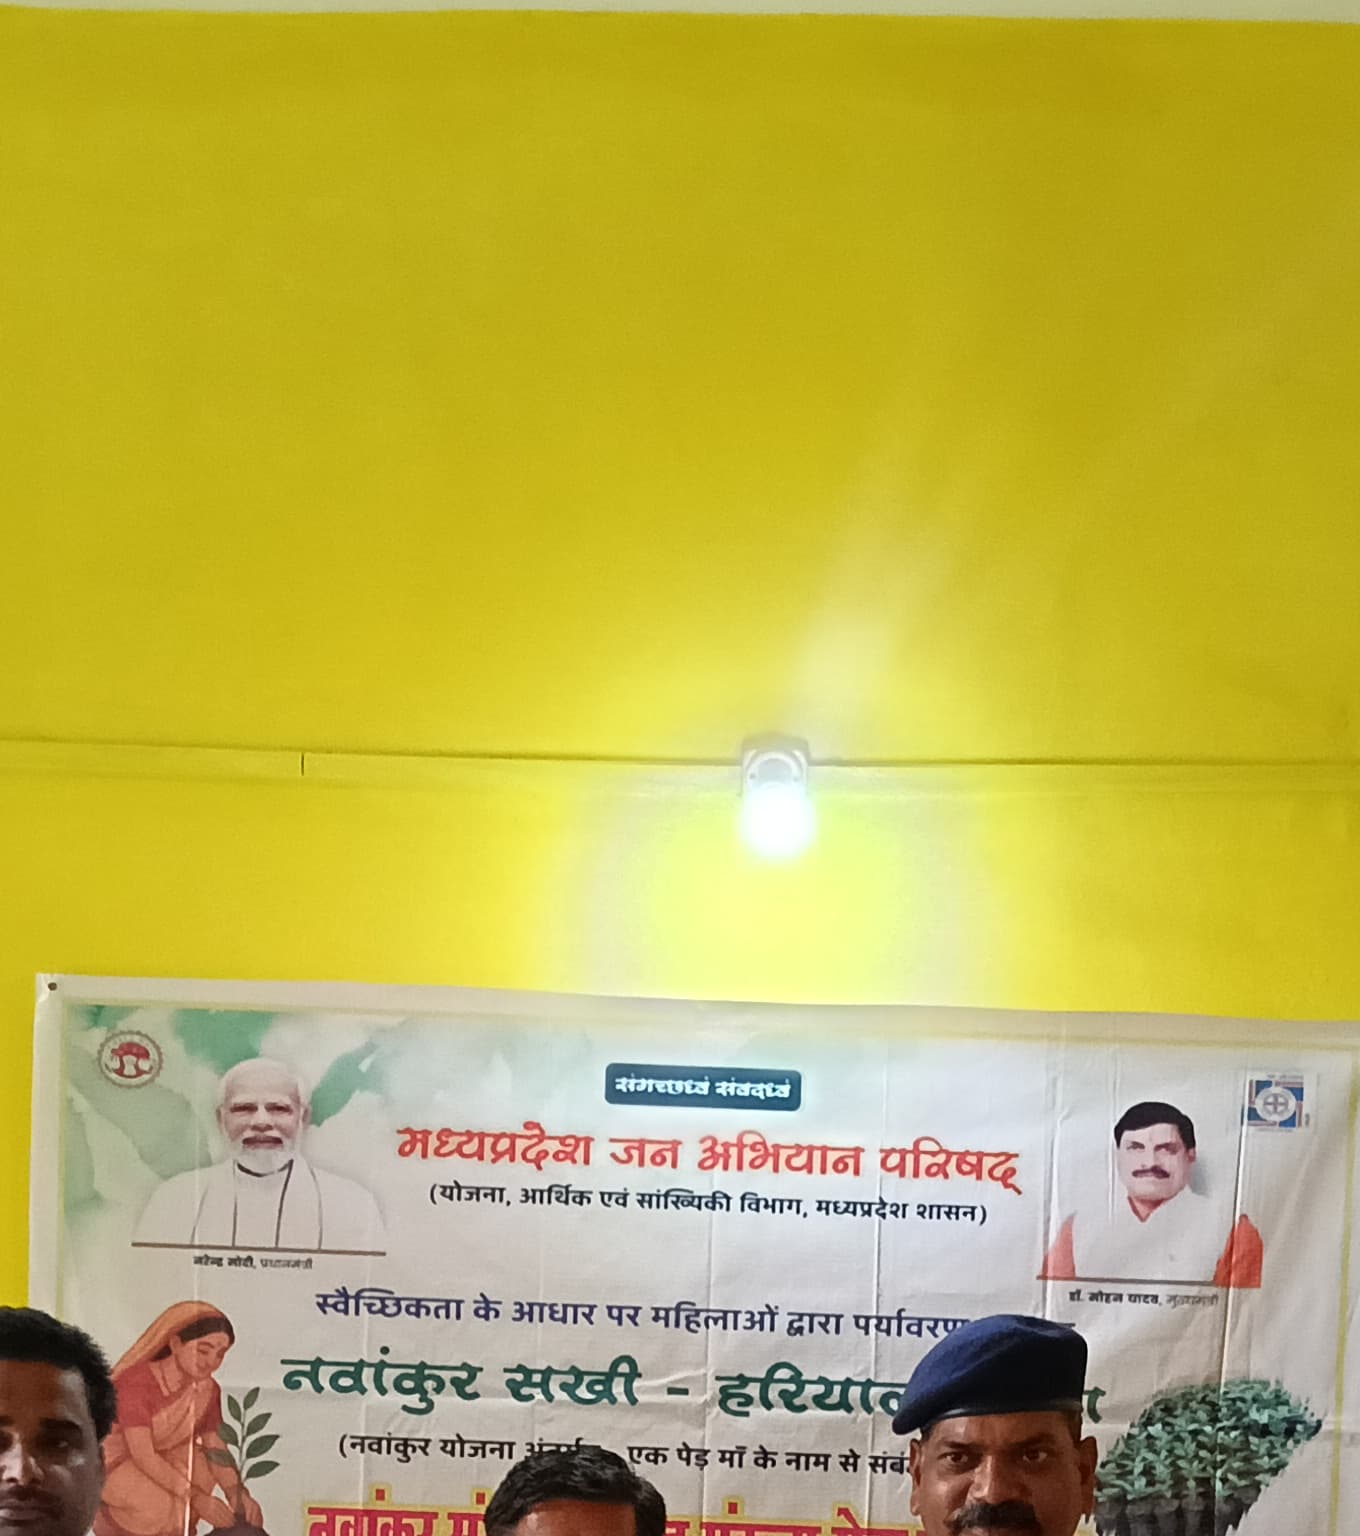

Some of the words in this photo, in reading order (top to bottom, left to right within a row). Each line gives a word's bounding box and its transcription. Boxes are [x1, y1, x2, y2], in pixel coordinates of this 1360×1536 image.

[396, 1120, 593, 1171] मध्यप्रदेश
[608, 1136, 681, 1169] जन
[696, 1128, 866, 1177] अभियान
[879, 1135, 1023, 1196] परिषद्
[428, 1180, 512, 1206] (योजना,
[519, 1183, 591, 1207] आर्थिक
[599, 1187, 629, 1209] एवं
[739, 1191, 809, 1219] विभाग,
[815, 1196, 909, 1221] मध्यप्रदेश
[915, 1200, 987, 1226] शासन)
[315, 1286, 465, 1320] स्वैच्छिकता
[473, 1292, 502, 1321] के
[511, 1300, 597, 1326] आधार
[606, 1302, 643, 1327] पर
[651, 1301, 779, 1334] महिलाओं
[786, 1311, 844, 1336] द्वारा
[280, 1345, 483, 1416] नवांकुर
[503, 1355, 642, 1407] सखी
[338, 1432, 432, 1463] (नवांकुर
[439, 1433, 516, 1460] योजना
[627, 1446, 669, 1466] एक
[676, 1441, 710, 1471] पेड़
[753, 1444, 778, 1470] के
[785, 1451, 832, 1472] नाम
[838, 1448, 861, 1473] से
